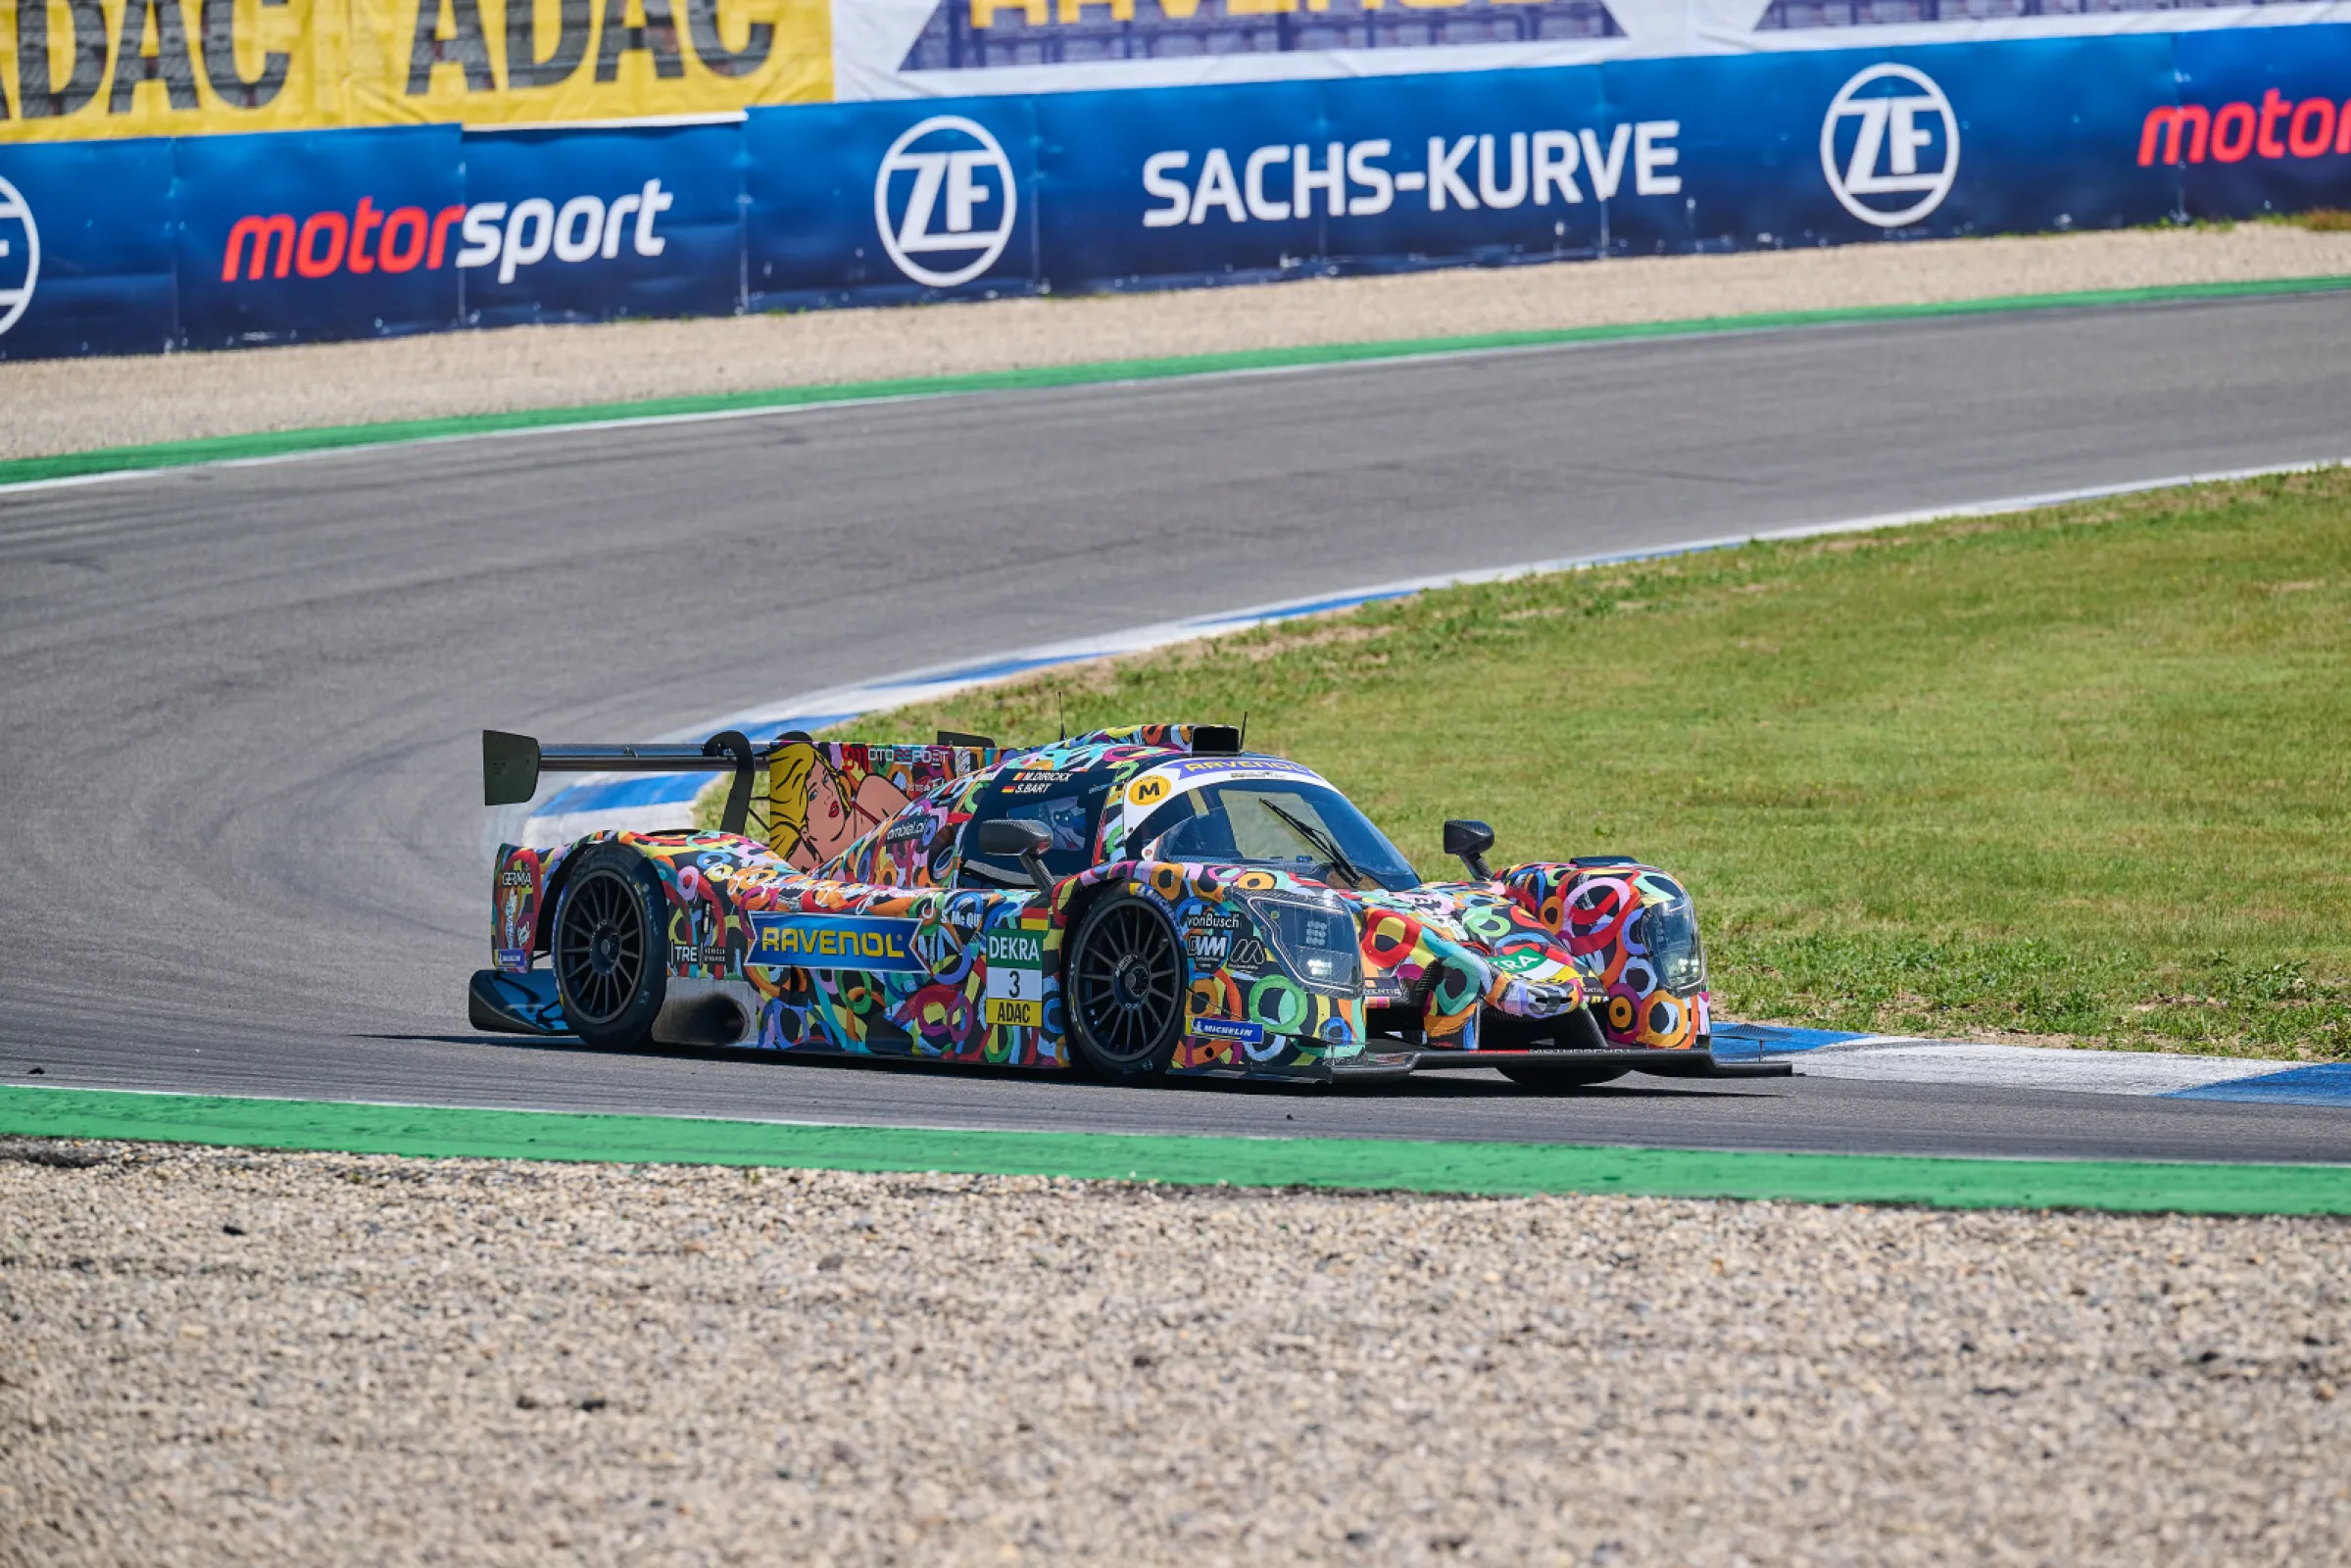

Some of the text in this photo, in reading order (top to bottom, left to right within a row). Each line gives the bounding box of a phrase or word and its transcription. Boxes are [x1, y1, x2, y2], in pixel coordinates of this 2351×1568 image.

[0, 0, 291, 120] DAC
[1142, 121, 1682, 227] SACHS-KURVE
[222, 179, 672, 283] motorsport
[1139, 782, 1160, 801] M
[1188, 913, 1240, 928] vonBusch
[675, 946, 698, 962] TRE
[761, 927, 905, 957] RAVENOL
[989, 936, 1040, 961] DEKRA
[1008, 970, 1020, 998] 3
[998, 1002, 1031, 1023] ADAC
[1203, 1024, 1253, 1037] MICHELIN
